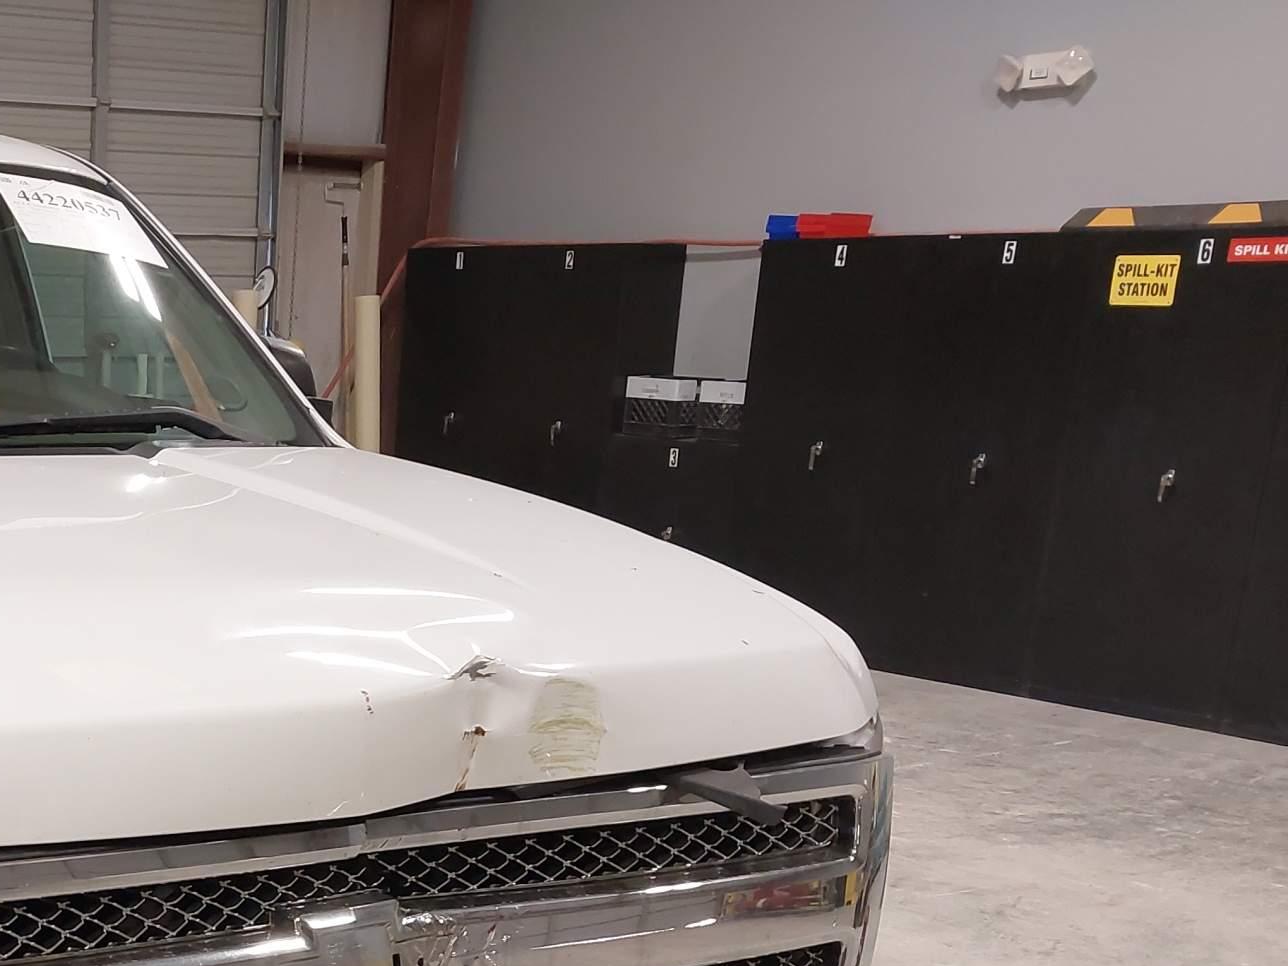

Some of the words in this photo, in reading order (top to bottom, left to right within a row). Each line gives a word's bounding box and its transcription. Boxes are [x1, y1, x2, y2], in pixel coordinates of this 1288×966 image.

[836, 246, 846, 265] 4
[1004, 243, 1015, 262] 5
[1200, 240, 1212, 263] 6
[1234, 244, 1270, 256] SPILL
[566, 251, 574, 268] 2
[1117, 263, 1177, 278] SPILL-KIT
[1118, 282, 1168, 297] STATION
[670, 450, 678, 466] 3
